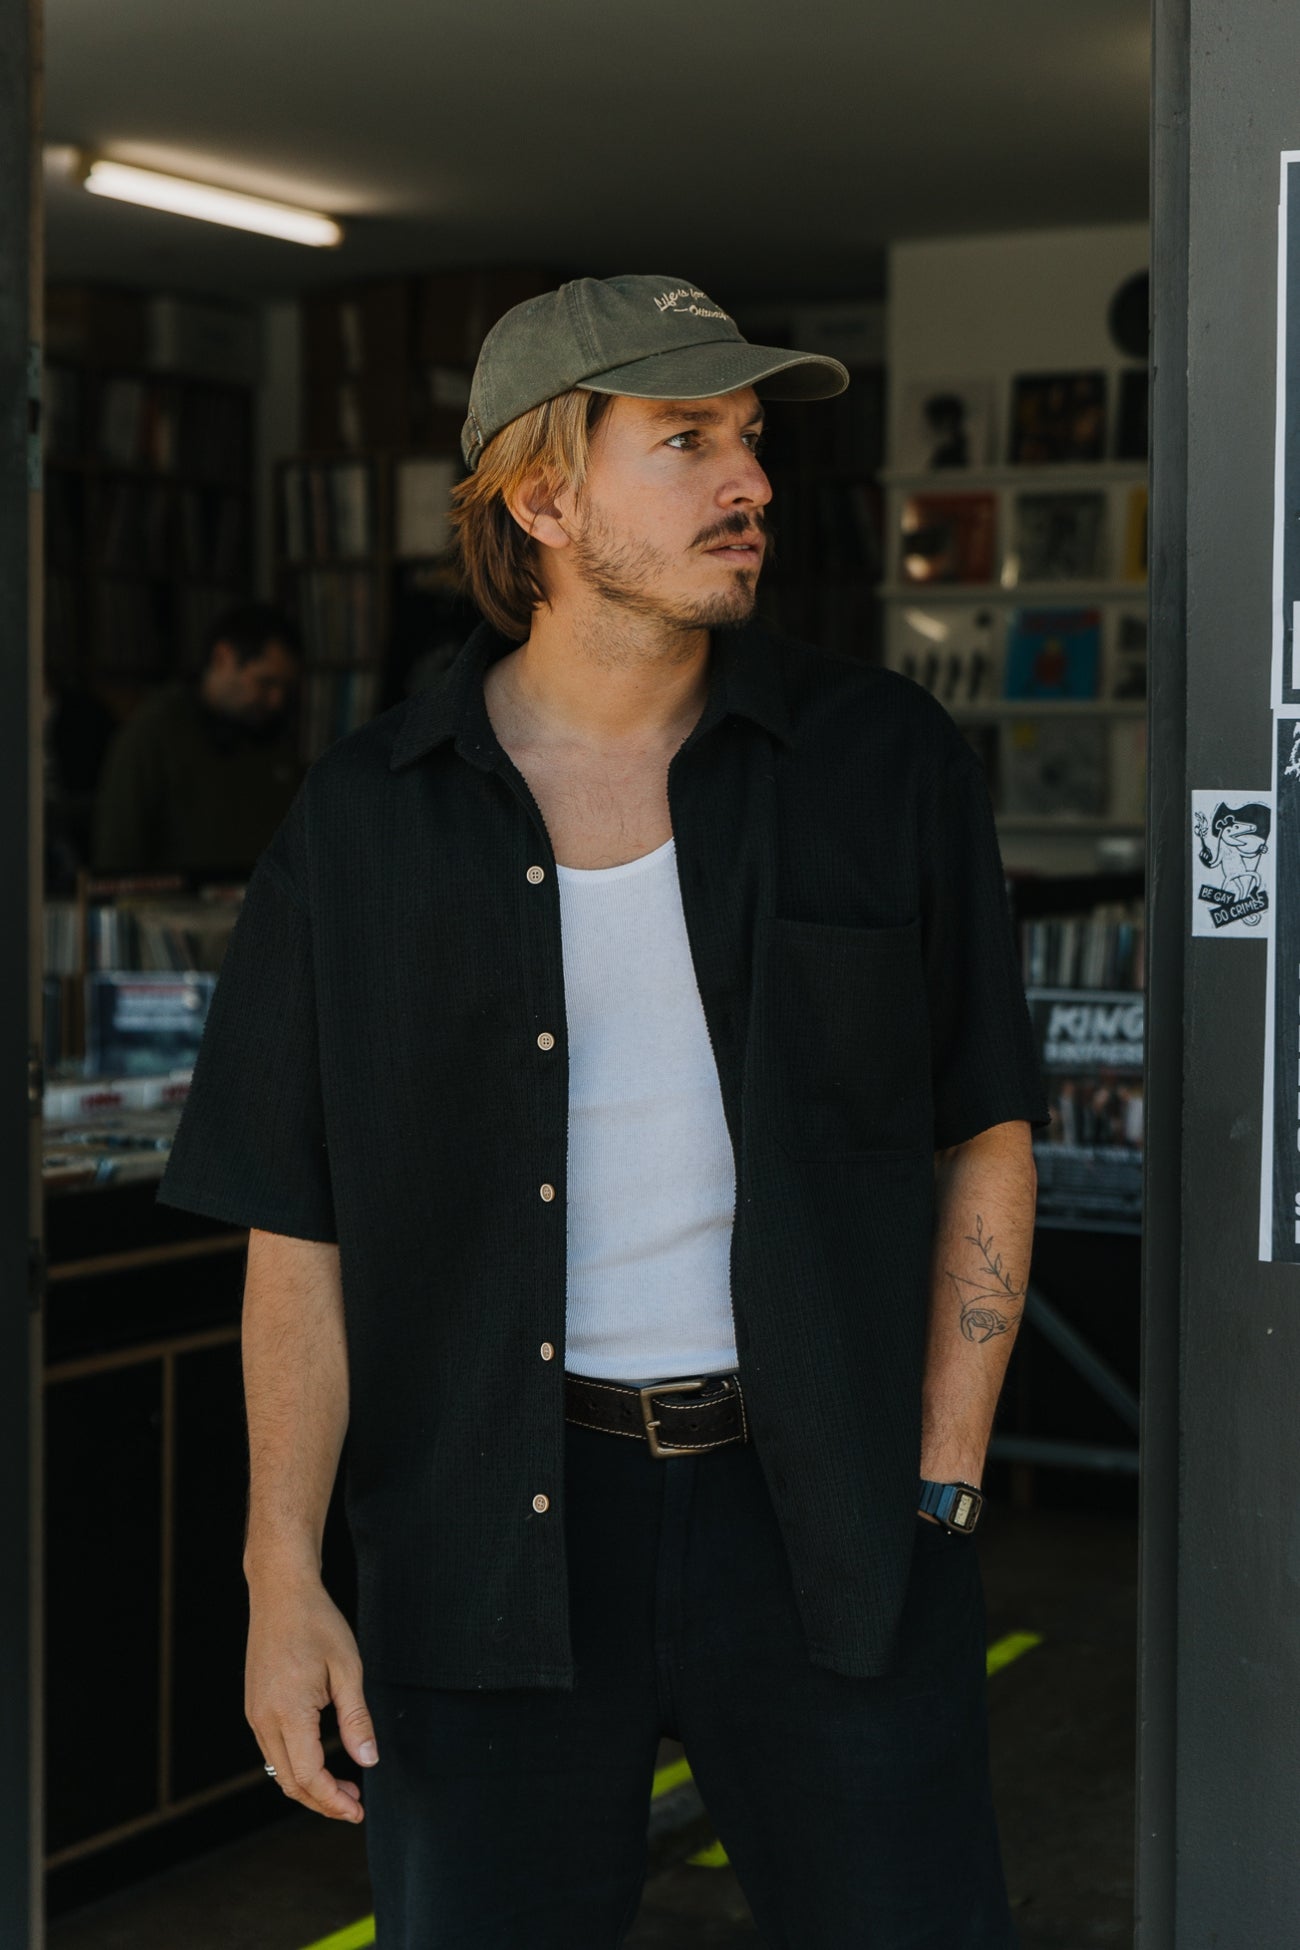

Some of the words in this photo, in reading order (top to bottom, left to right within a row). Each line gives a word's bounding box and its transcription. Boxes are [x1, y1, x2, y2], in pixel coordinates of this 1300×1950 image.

[1201, 887, 1214, 899] BE
[1214, 891, 1233, 904] GAY
[1213, 909, 1229, 924] DO
[1230, 895, 1265, 918] CRIMES
